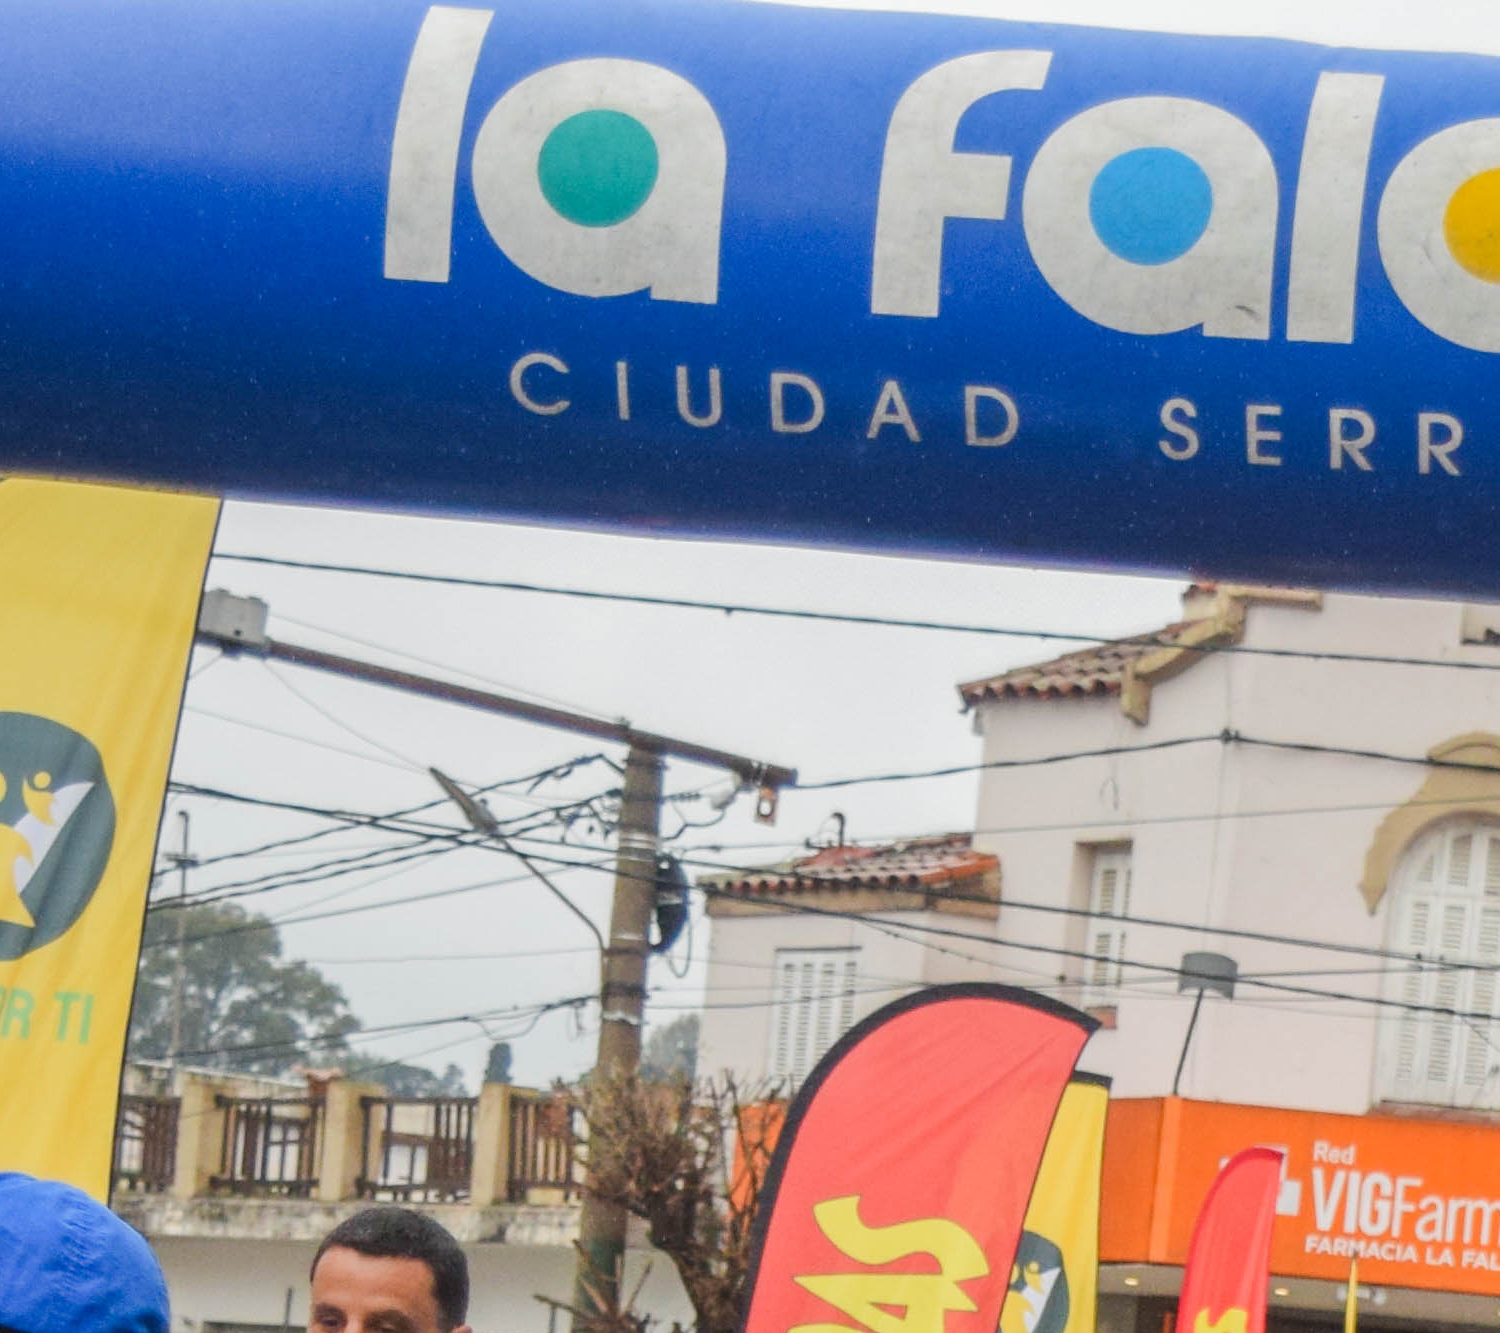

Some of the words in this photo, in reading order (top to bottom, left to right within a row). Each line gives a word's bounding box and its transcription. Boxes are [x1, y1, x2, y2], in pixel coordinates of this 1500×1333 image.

[382, 6, 728, 305] la
[511, 352, 1020, 448] CIUDAD
[53, 990, 95, 1045] TI
[1313, 1139, 1356, 1165] Red
[1305, 1235, 1417, 1263] FARMACIA
[1425, 1248, 1454, 1267] LA
